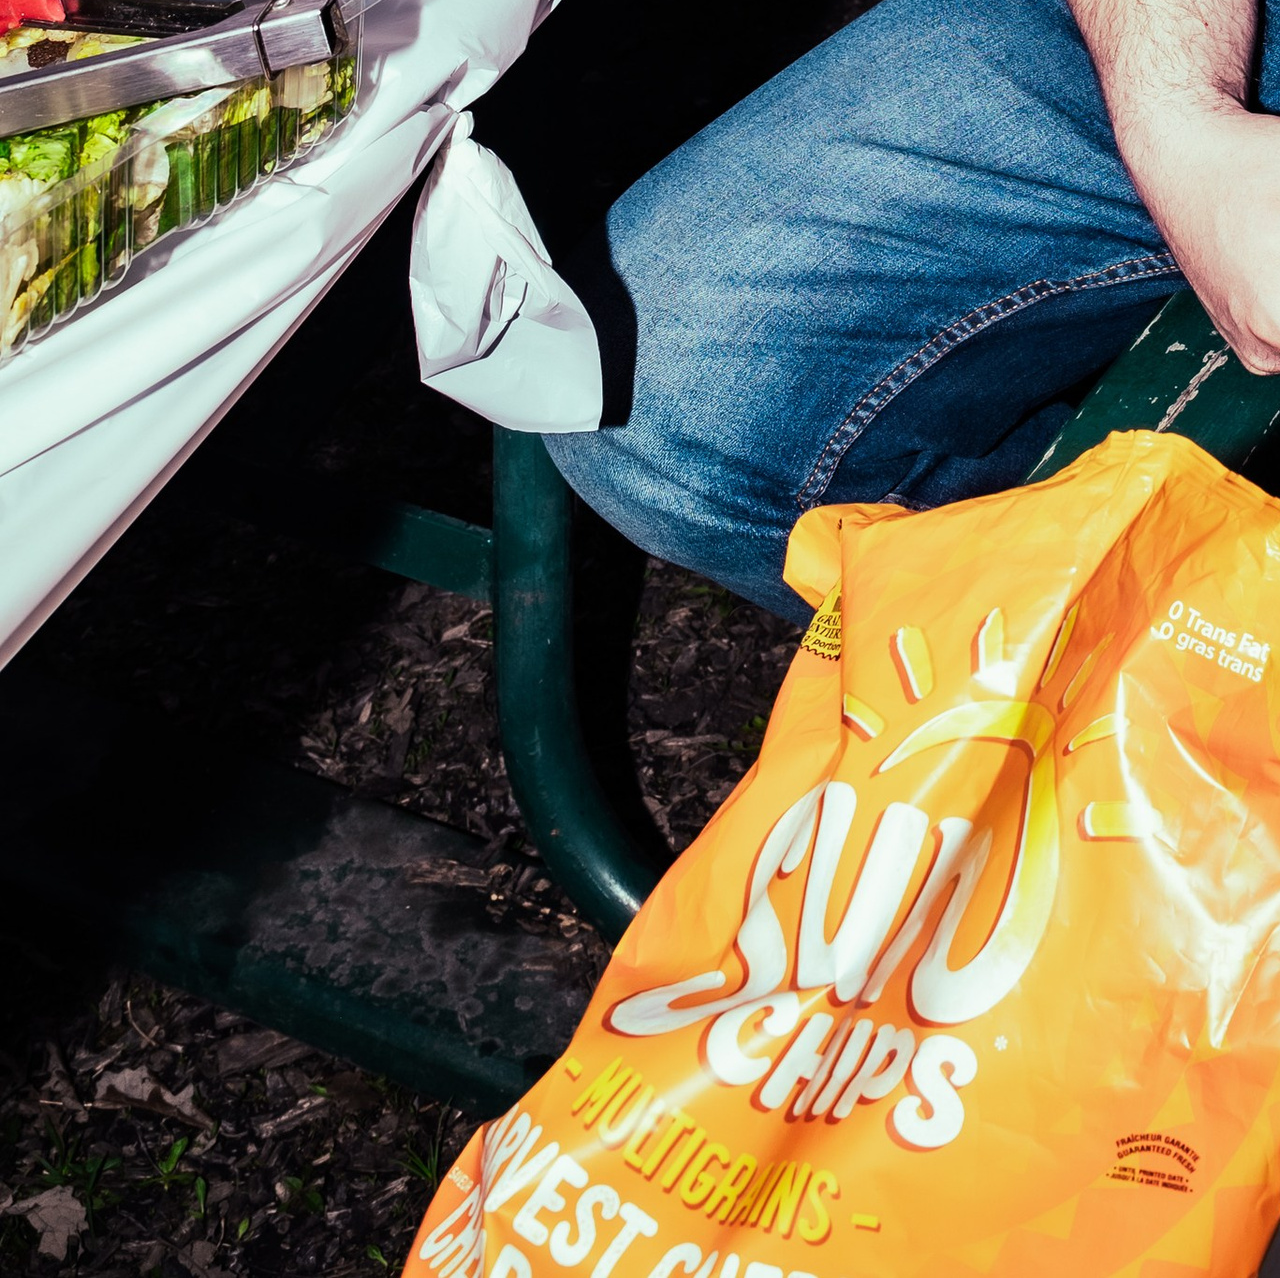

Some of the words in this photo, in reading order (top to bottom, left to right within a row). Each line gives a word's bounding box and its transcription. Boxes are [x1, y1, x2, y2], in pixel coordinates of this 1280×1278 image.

[1168, 600, 1184, 621] 0
[1186, 607, 1237, 648] Trans
[1237, 632, 1271, 664] Fat
[1175, 632, 1215, 660] gras
[1217, 649, 1264, 683] trans
[608, 780, 1060, 1036] SUN
[705, 992, 978, 1148] CHIPS
[571, 1056, 841, 1243] MULTIGRAINS
[1116, 1133, 1162, 1148] FRAÎCHEUR
[1164, 1136, 1200, 1163] GARANTIE
[1117, 1145, 1172, 1159] GUARANTEED
[1172, 1152, 1196, 1174] FRESH
[1167, 1174, 1184, 1183] DATE
